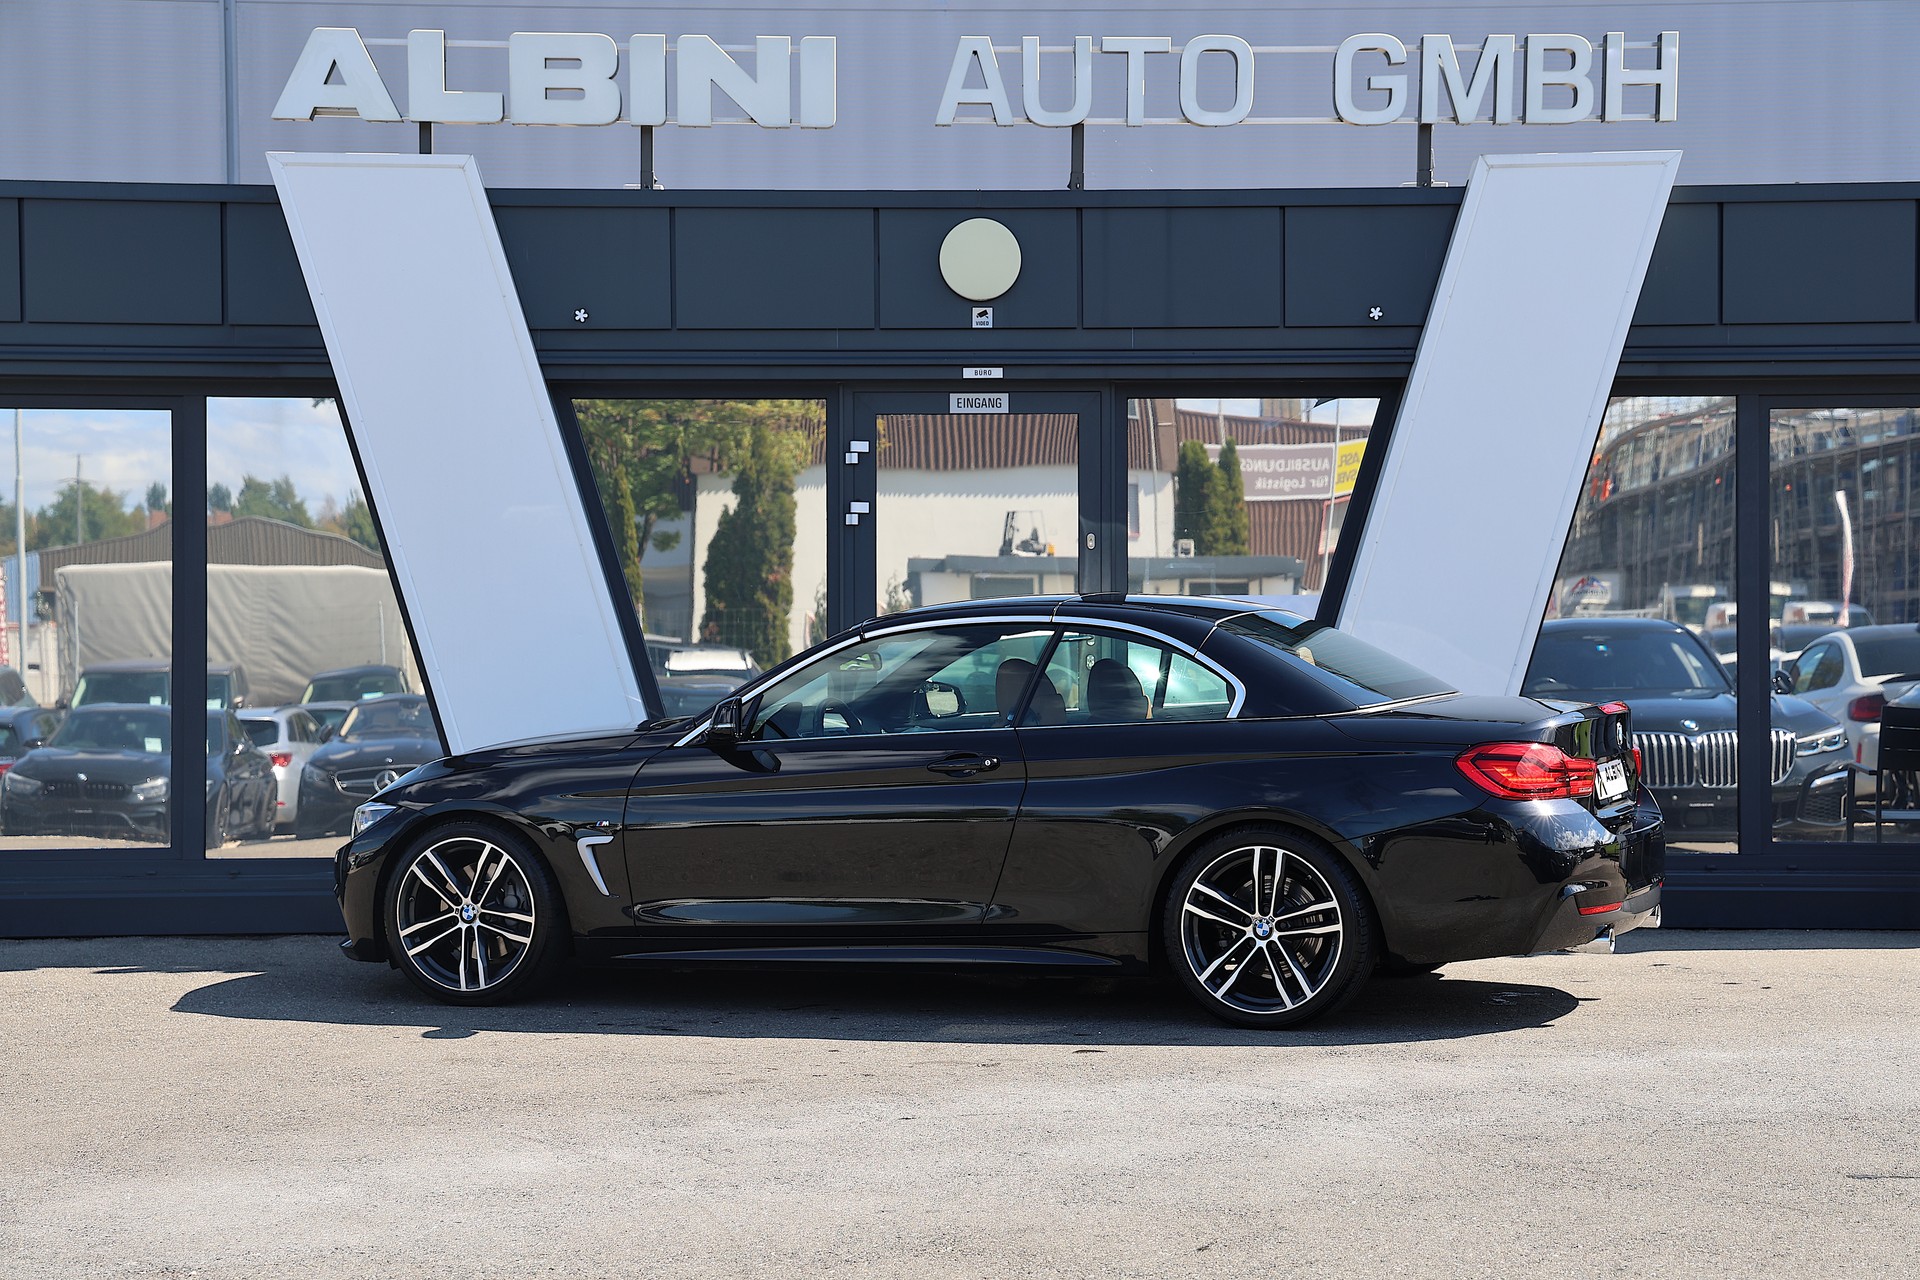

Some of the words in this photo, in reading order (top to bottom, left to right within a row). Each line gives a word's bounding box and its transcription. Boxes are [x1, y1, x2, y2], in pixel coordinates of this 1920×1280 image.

[270, 27, 837, 128] ALBINI
[935, 34, 1255, 127] AUTO
[1332, 30, 1680, 126] GMBH
[957, 397, 1002, 409] EINGANG
